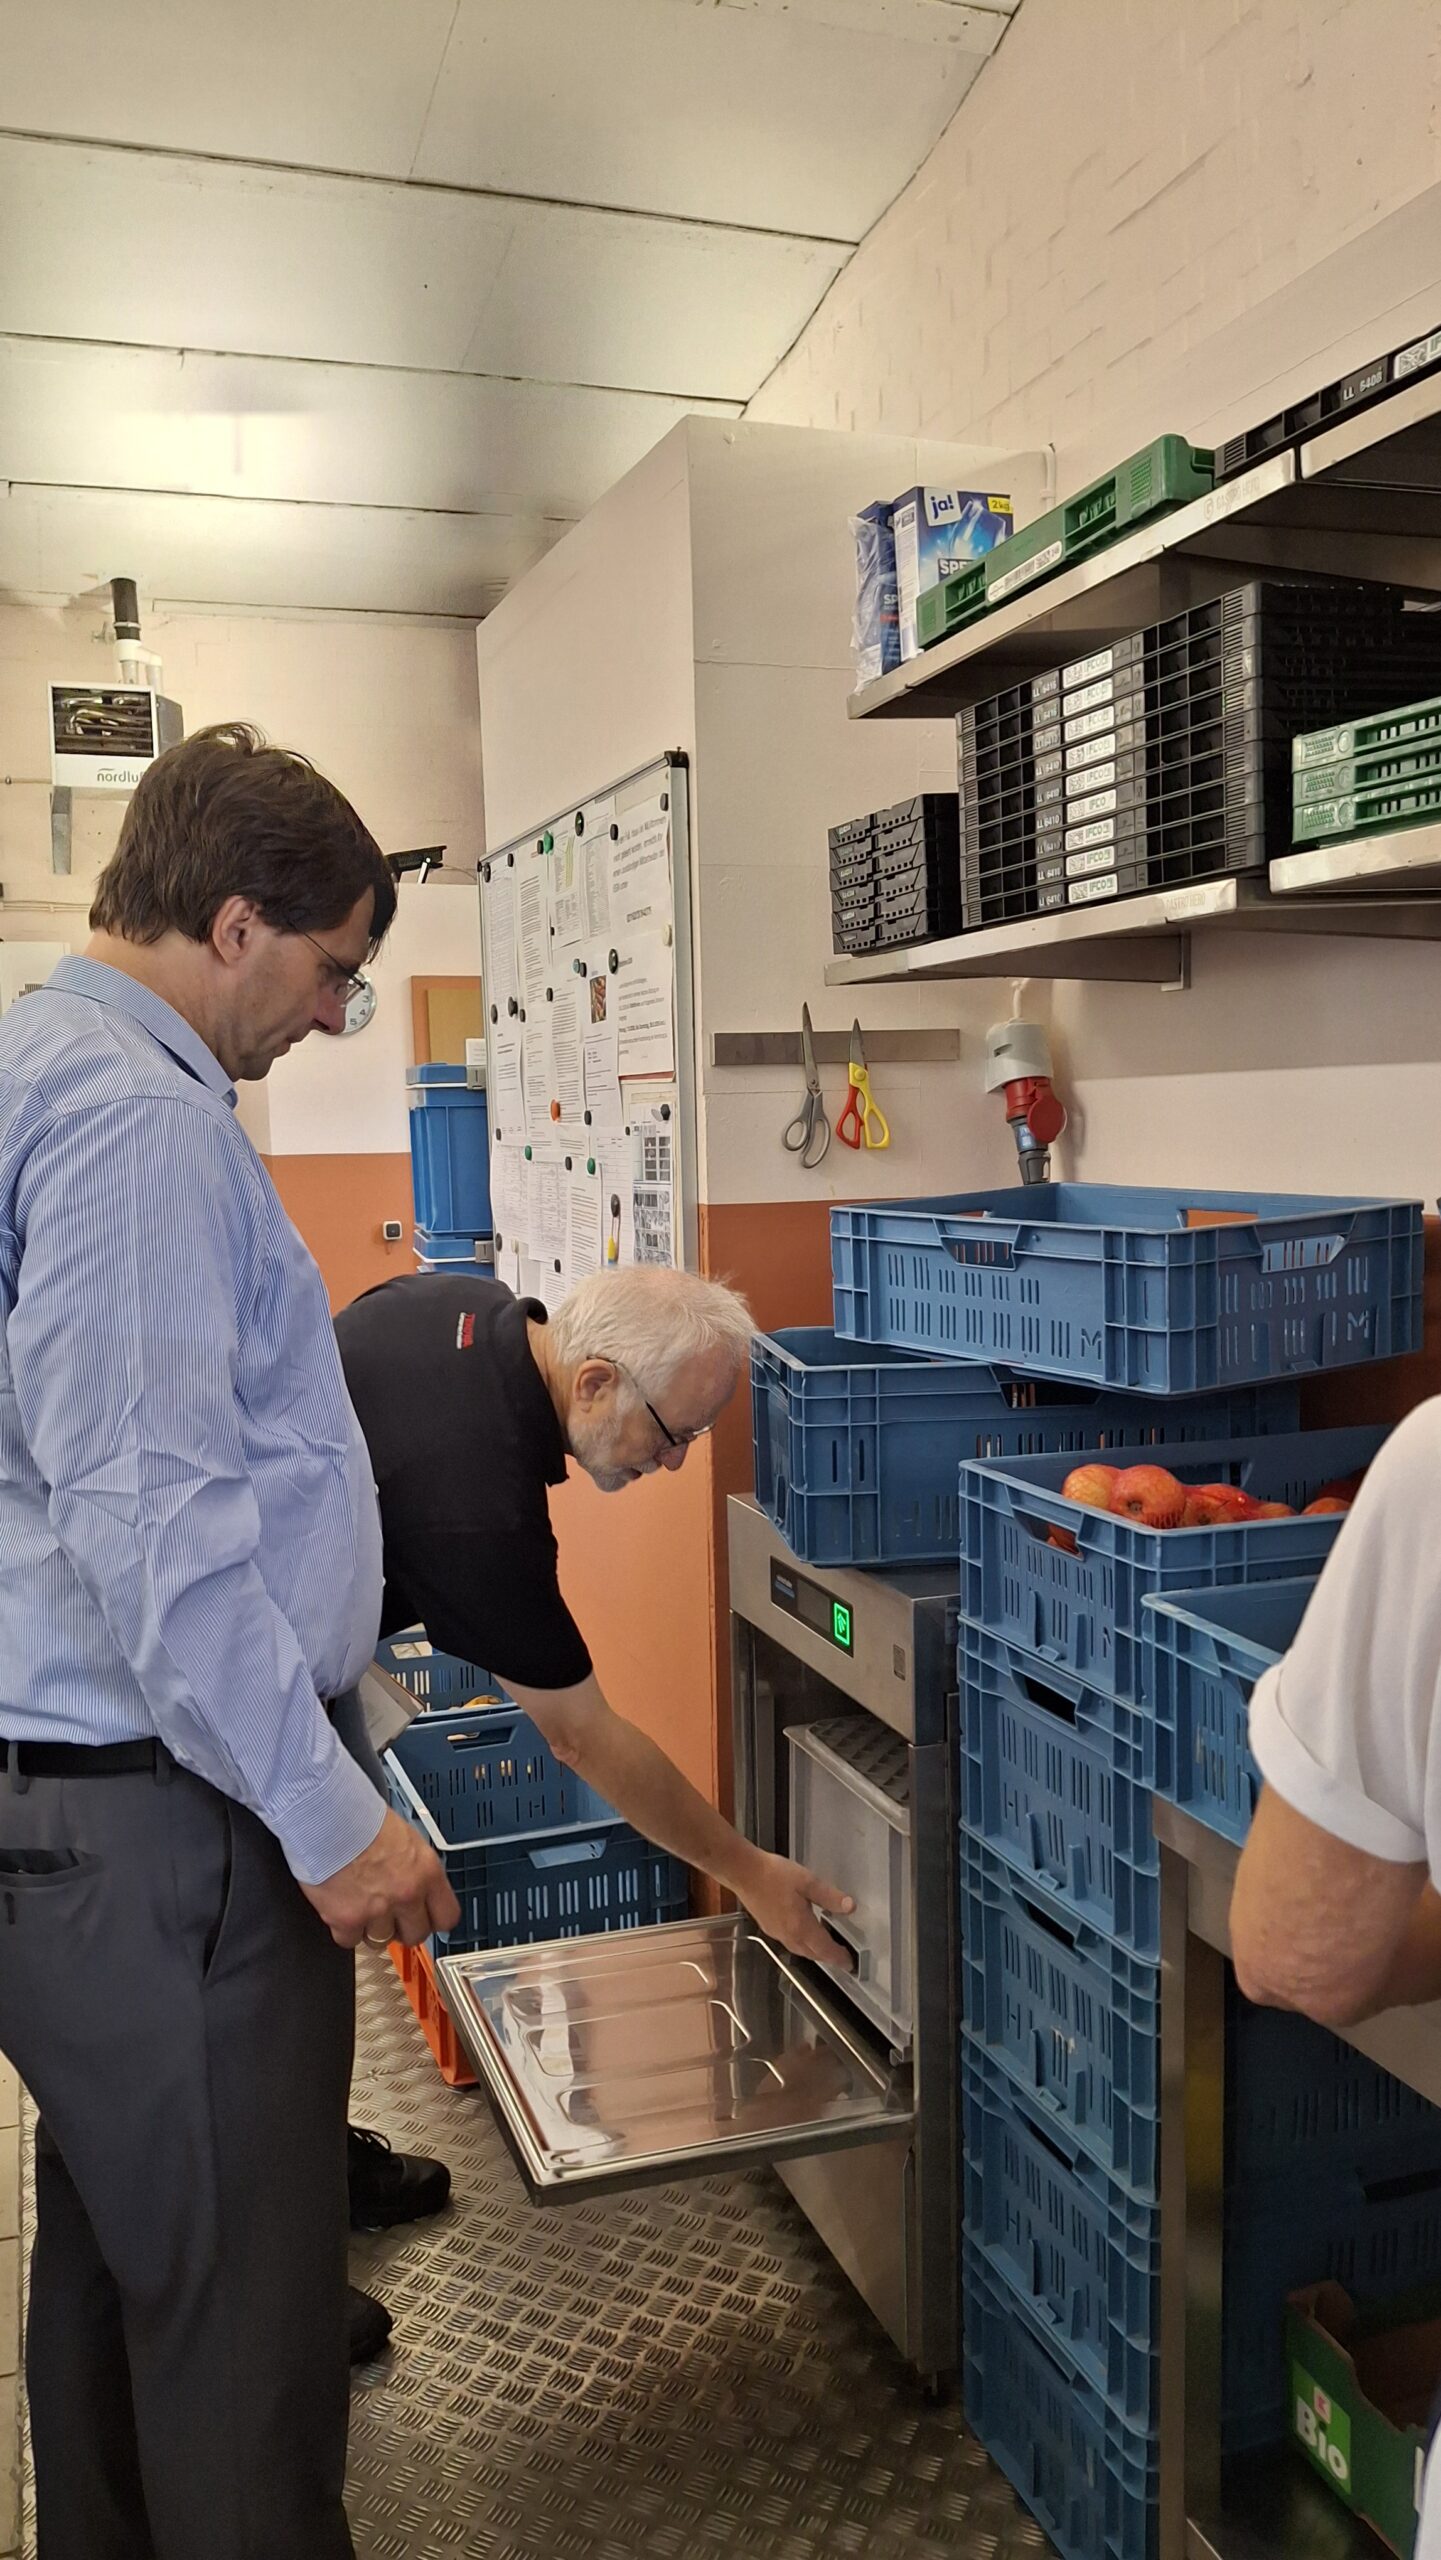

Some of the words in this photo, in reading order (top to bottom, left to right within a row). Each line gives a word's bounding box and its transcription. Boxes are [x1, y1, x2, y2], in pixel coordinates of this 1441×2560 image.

[1343, 386, 1354, 400] LL
[930, 494, 954, 519] ja!
[97, 768, 143, 783] nordlu
